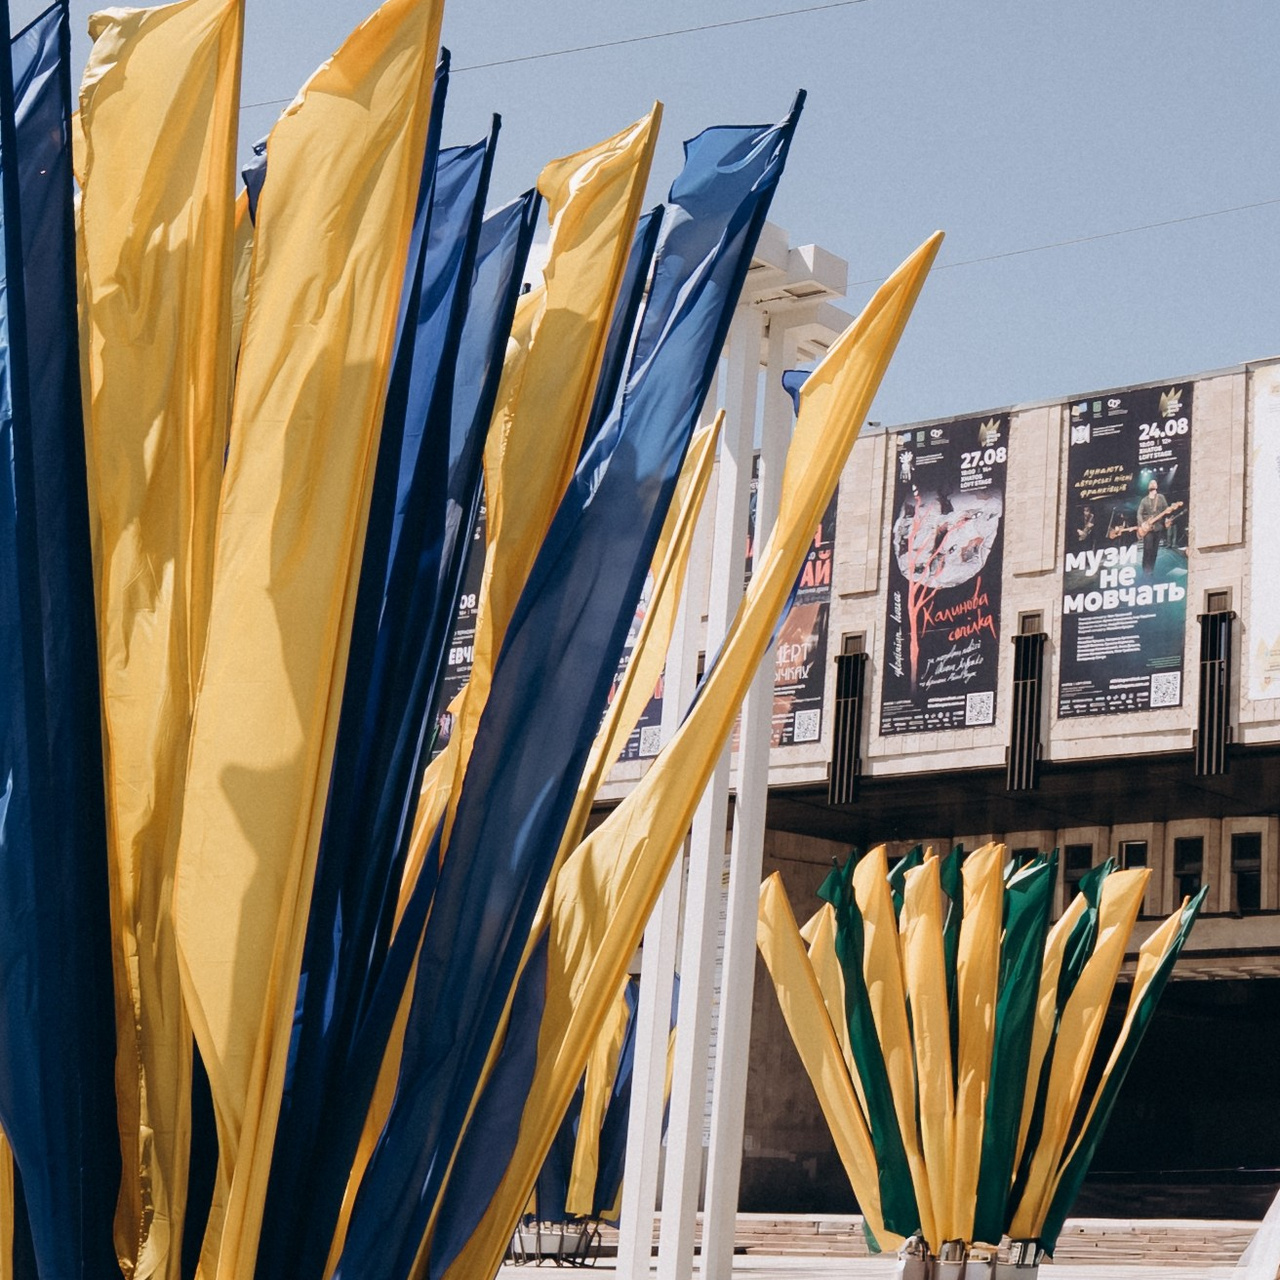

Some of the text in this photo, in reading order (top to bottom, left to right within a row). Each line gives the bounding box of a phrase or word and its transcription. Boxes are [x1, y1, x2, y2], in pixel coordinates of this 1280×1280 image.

[1138, 417, 1189, 441] 24.08
[960, 447, 1007, 469] 27.08
[1065, 544, 1138, 577] музи
[1099, 566, 1137, 589] не
[921, 576, 990, 638] Калинова
[1063, 582, 1186, 614] мовчать
[948, 609, 997, 642] сопілка
